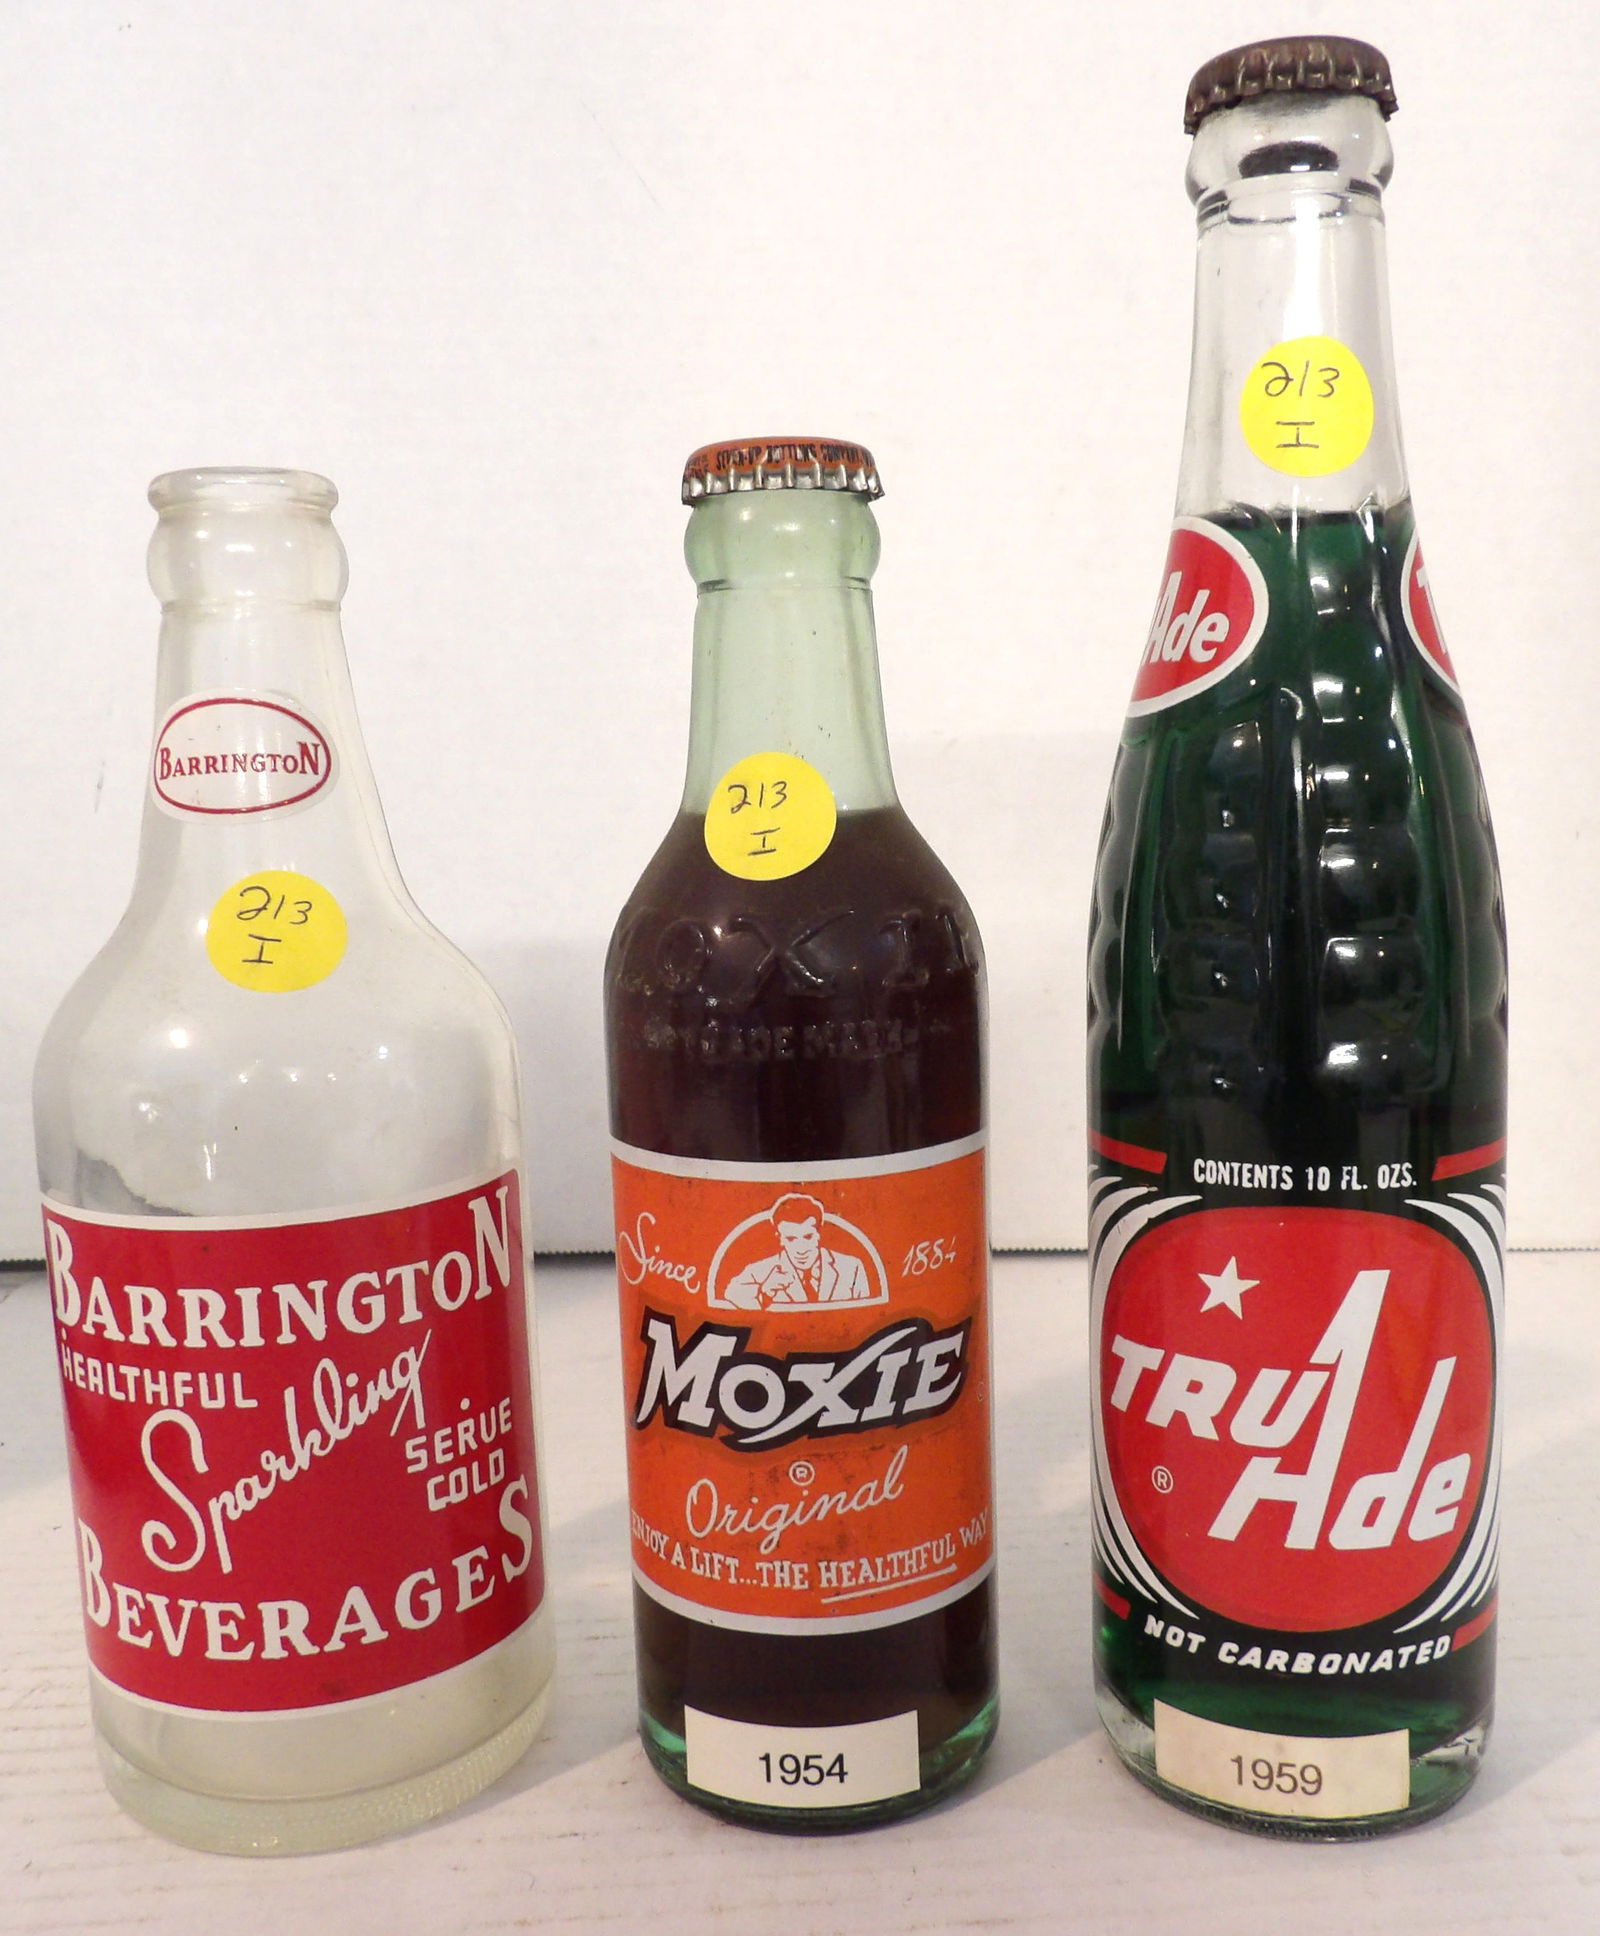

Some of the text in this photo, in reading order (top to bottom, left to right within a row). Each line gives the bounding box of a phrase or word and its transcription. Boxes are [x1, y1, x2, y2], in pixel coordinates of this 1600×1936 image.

[1260, 360, 1340, 398] 213
[1140, 570, 1230, 664] Ade
[158, 741, 321, 780] BARRINGTON
[727, 780, 788, 815] 213
[236, 886, 313, 925] 213
[1193, 1158, 1417, 1192] CONTENTS 10 FL. OZS.
[47, 1186, 511, 1348] BARRINGTON
[619, 1211, 700, 1294] Since
[902, 1235, 957, 1277] 1884
[60, 1327, 259, 1409] HEALTHFUL
[636, 1318, 965, 1445] MOXIE
[1111, 1334, 1331, 1449] TRU
[1206, 1268, 1472, 1551] Ade
[141, 1328, 432, 1575] Sparkling
[426, 1447, 506, 1513] COLD
[685, 1444, 909, 1555] Original
[77, 1472, 534, 1662] BEVERAGES
[631, 1508, 670, 1561] ENJOY
[671, 1541, 688, 1570] A
[820, 1532, 956, 1588] HEALTHFUL
[959, 1505, 988, 1549] WAY
[1143, 1613, 1453, 1675] NOT CARBONATED
[757, 1753, 849, 1786] 1954
[1229, 1755, 1324, 1798] 1959
